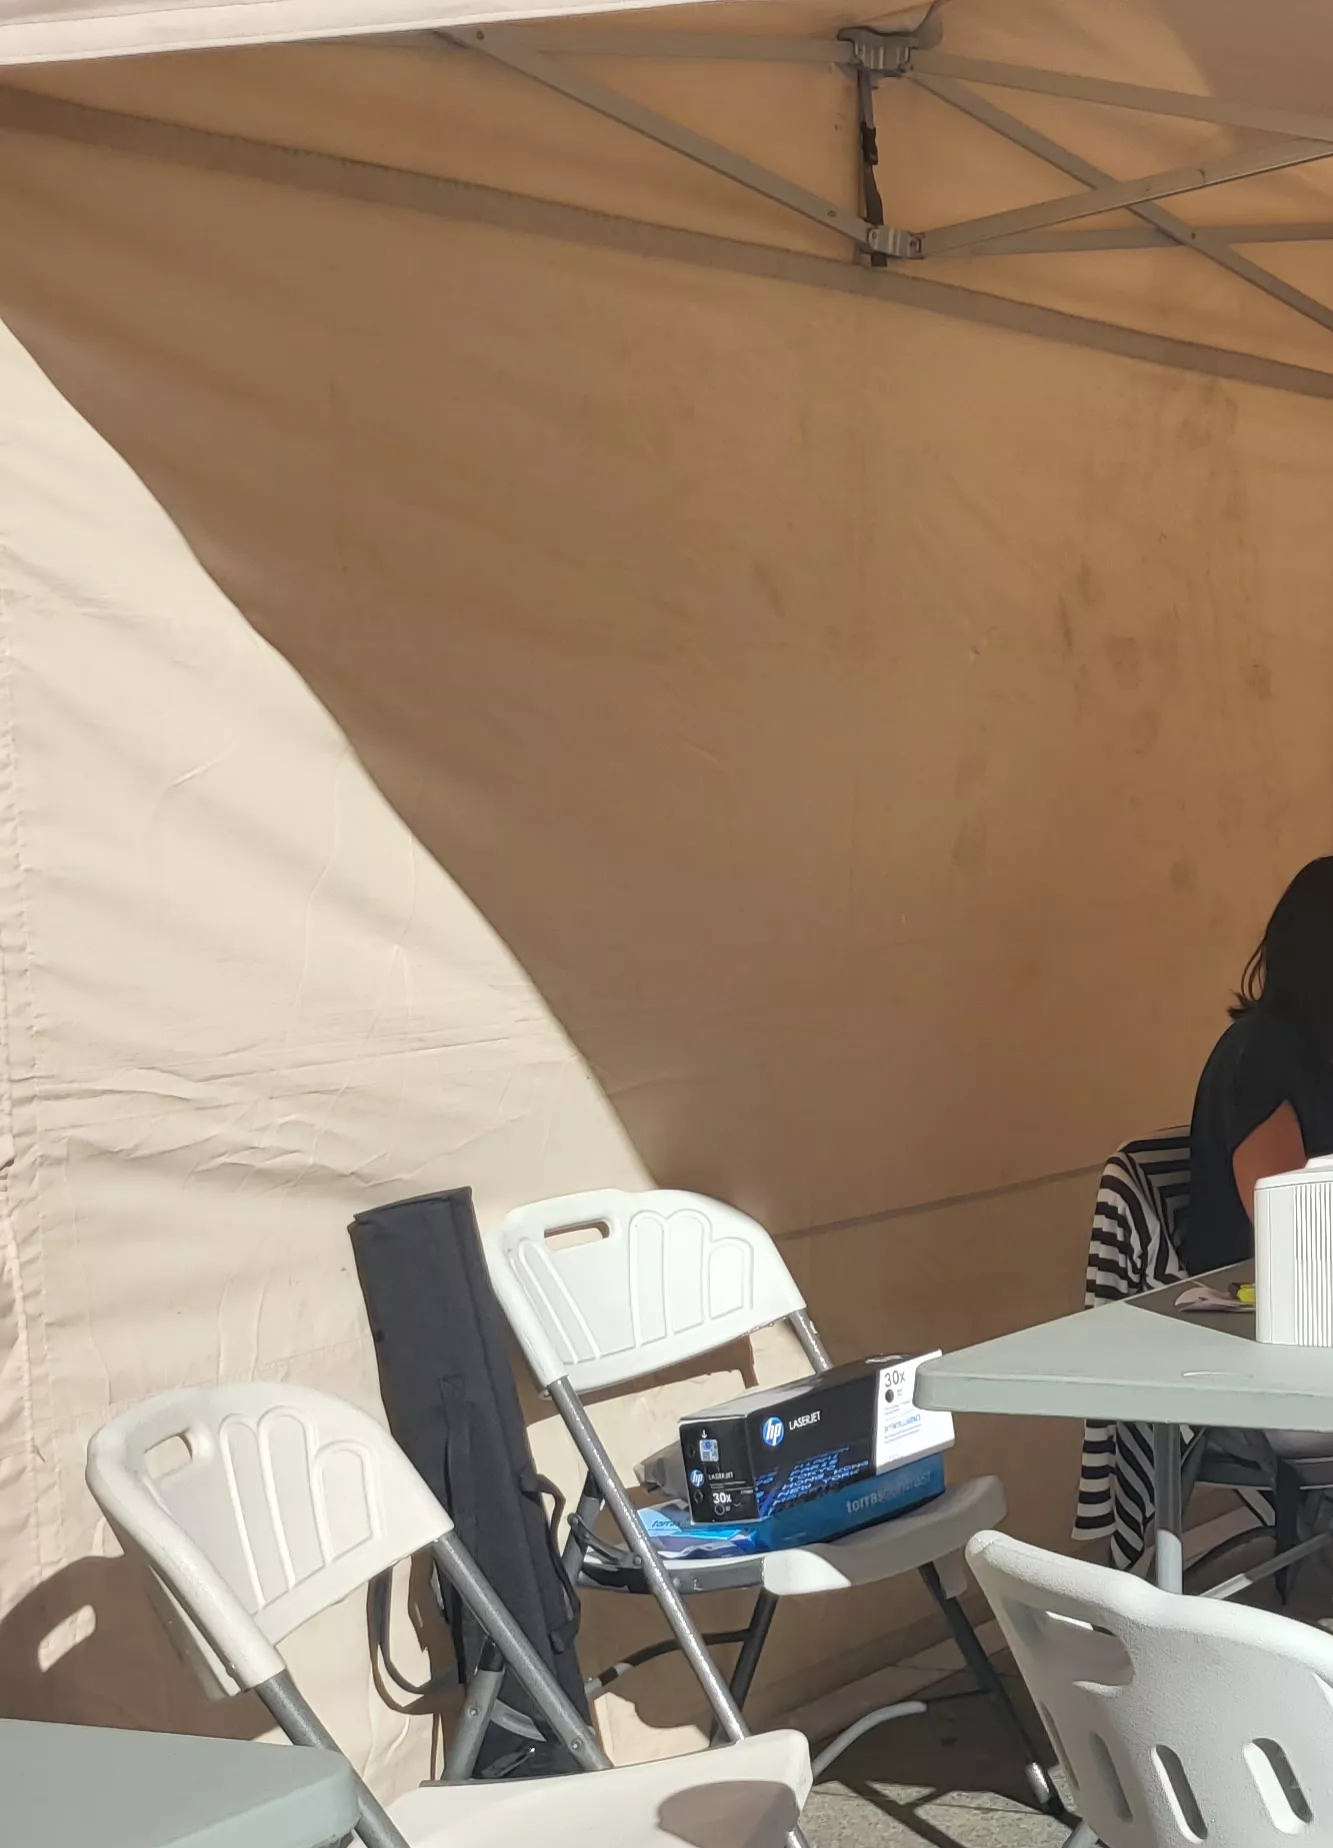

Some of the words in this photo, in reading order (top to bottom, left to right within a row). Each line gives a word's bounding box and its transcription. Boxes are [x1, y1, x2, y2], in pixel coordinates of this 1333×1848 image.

[764, 1417, 783, 1446] hp
[789, 1410, 821, 1431] LASERJET
[692, 1469, 704, 1487] hp
